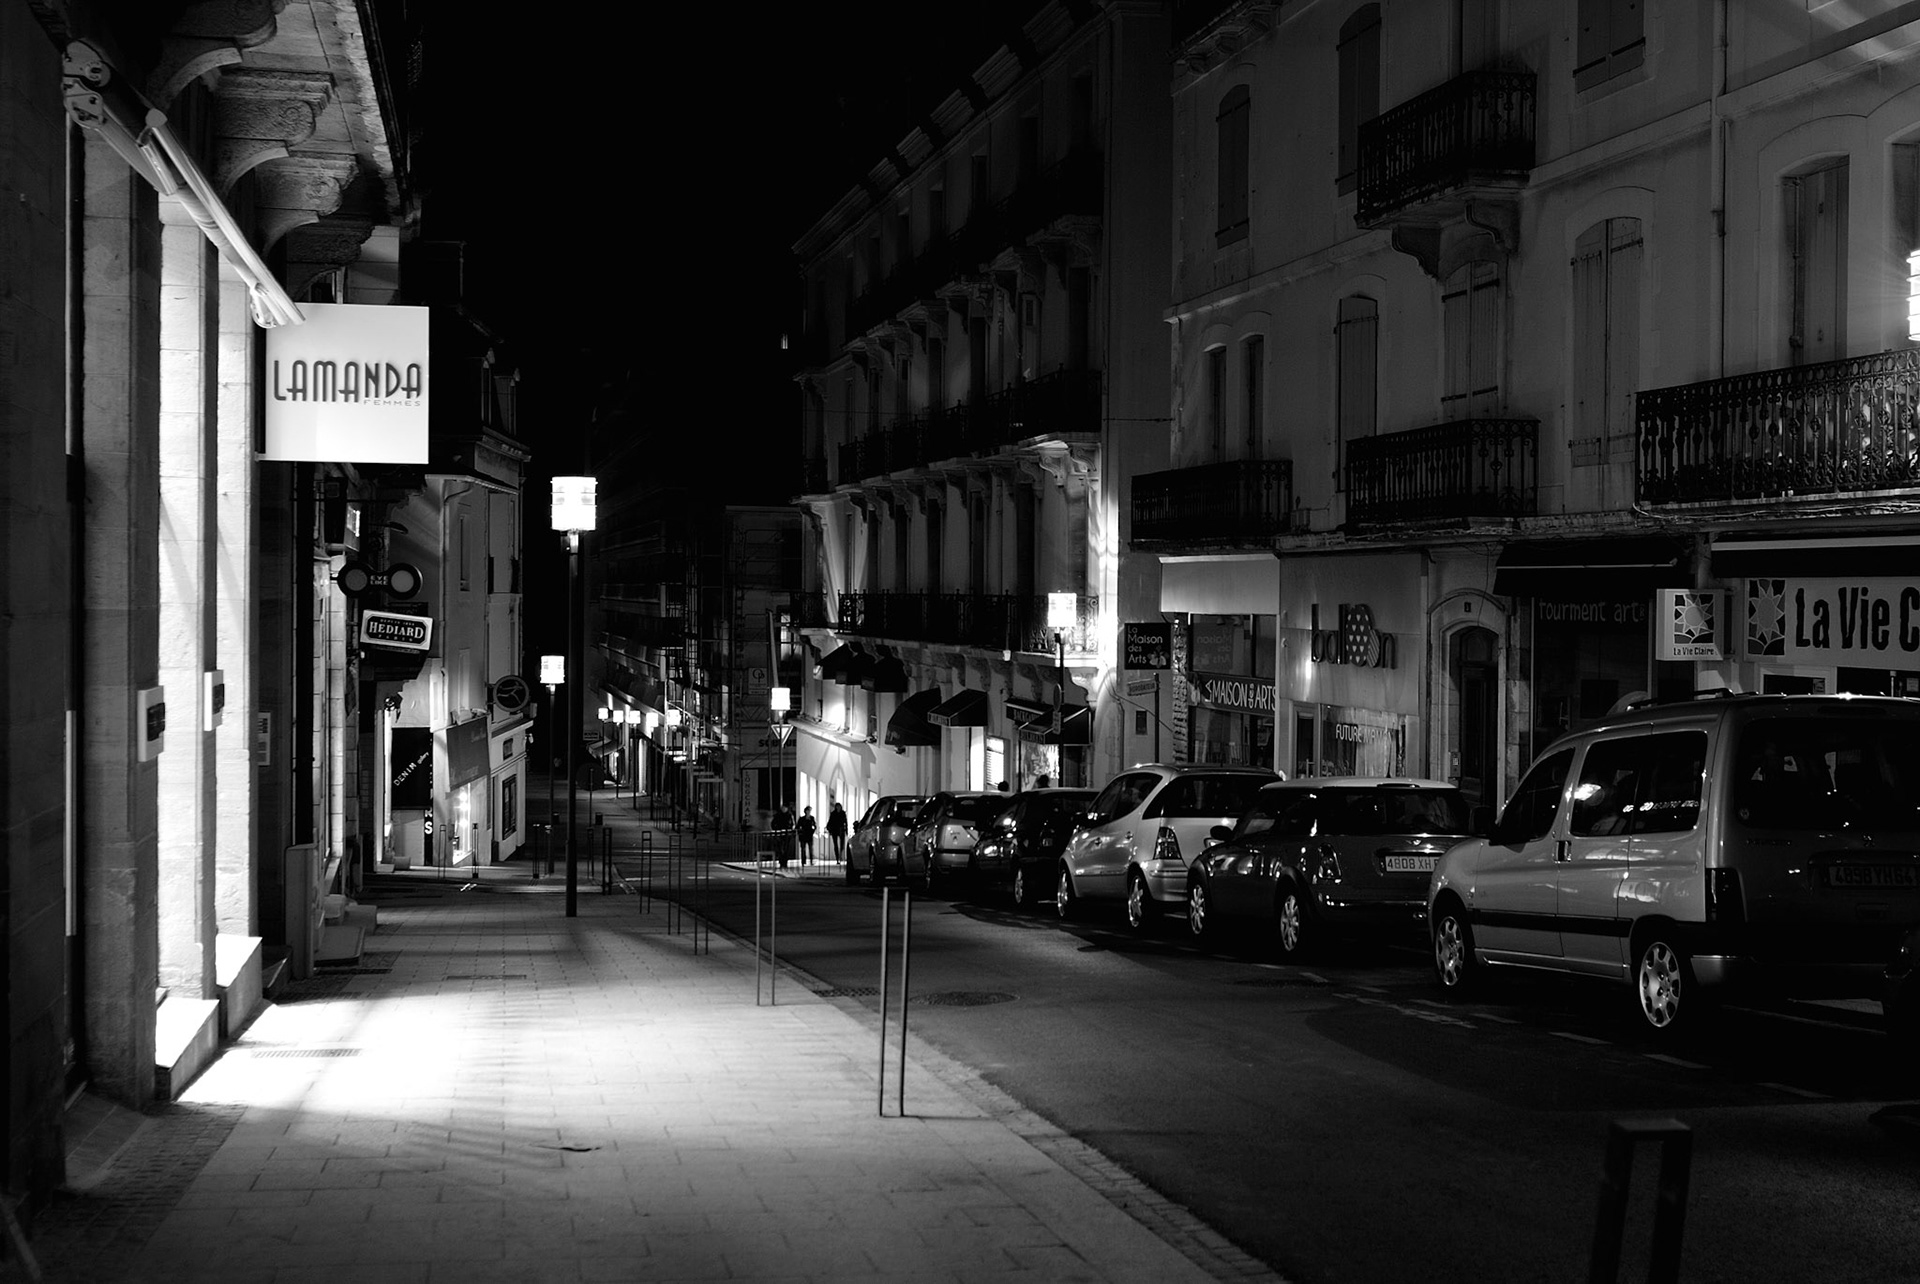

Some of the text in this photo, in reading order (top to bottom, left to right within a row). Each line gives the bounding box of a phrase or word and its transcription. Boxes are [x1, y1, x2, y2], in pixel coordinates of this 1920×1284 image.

[274, 360, 421, 402] LAMANDA
[1796, 588, 1830, 649] La
[1838, 586, 1890, 650] Vie
[369, 621, 425, 639] HEDIARD
[1128, 625, 1138, 634] La
[1127, 634, 1163, 644] Maison
[1128, 644, 1142, 653] des
[1673, 647, 1714, 656] La Vie Claire
[1128, 656, 1147, 664] Arts
[1212, 680, 1248, 707] MAISON
[1254, 684, 1275, 711] ARTS
[1336, 723, 1362, 743] FUTURE
[393, 762, 417, 786] DENIM
